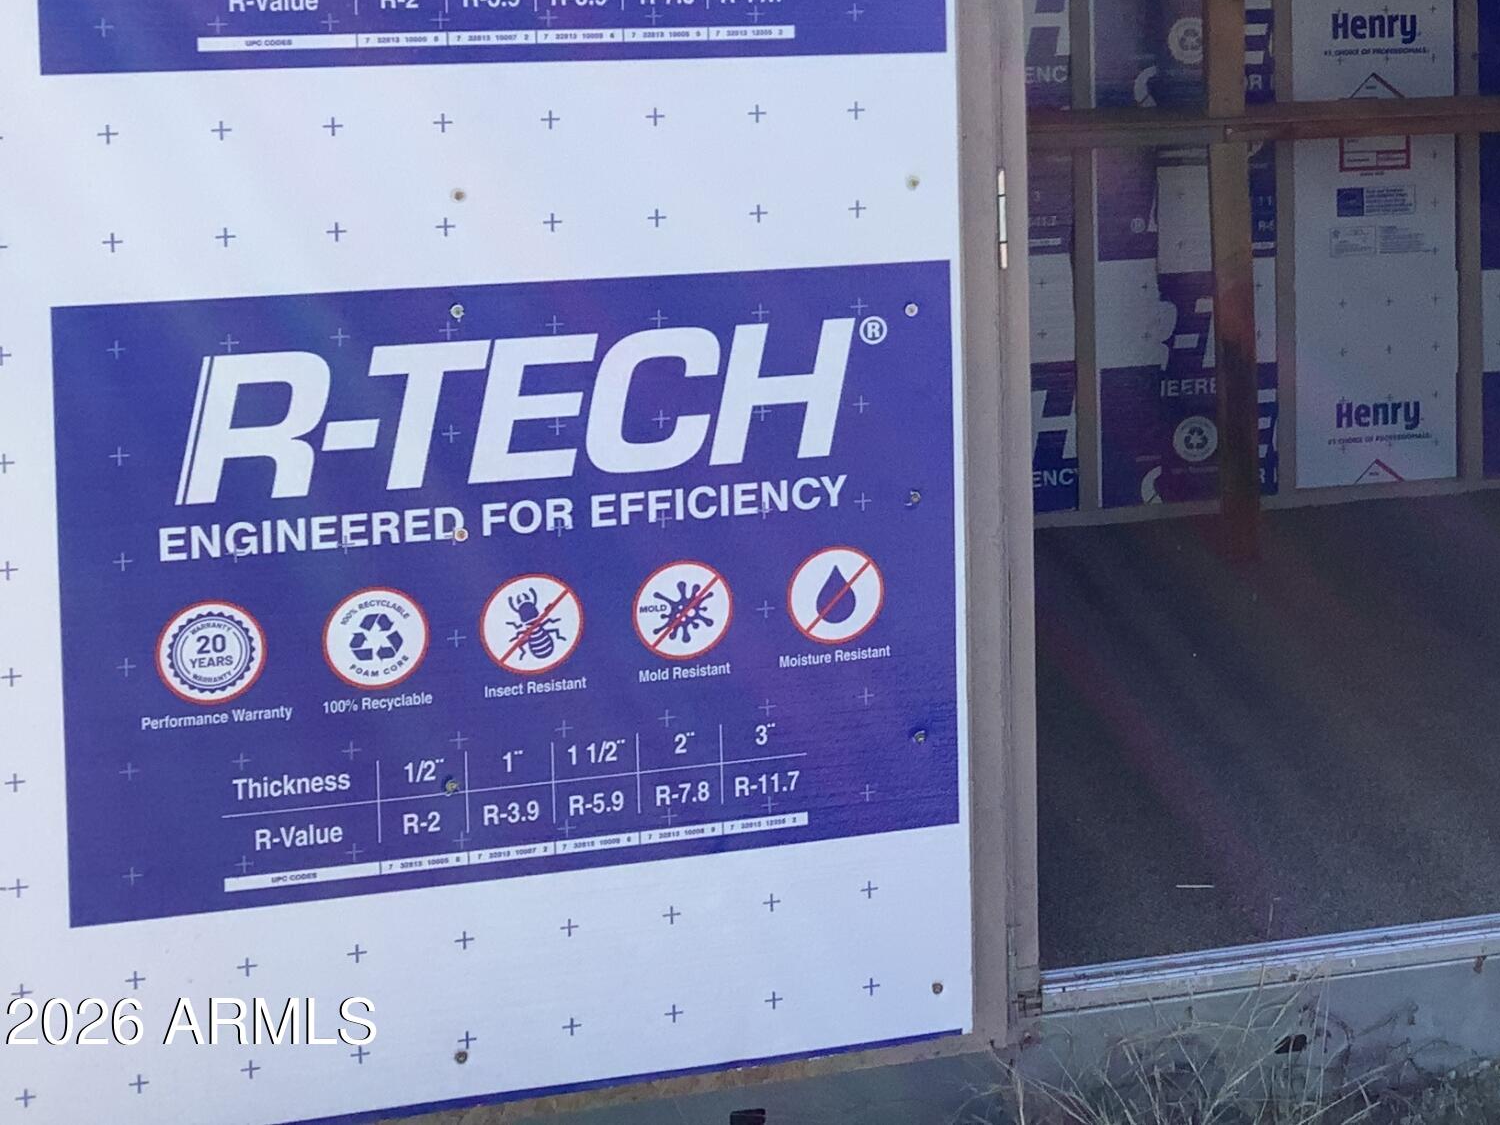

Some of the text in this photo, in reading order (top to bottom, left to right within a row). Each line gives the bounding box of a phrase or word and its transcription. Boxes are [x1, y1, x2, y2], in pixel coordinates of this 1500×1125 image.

[1331, 12, 1418, 45] Henry
[245, 39, 262, 47] UPC
[264, 38, 292, 47] CODES
[1336, 400, 1421, 431] Henry
[159, 475, 848, 562] ENGINEERED FOR EFFICIENCY
[357, 599, 411, 619] RECYCLABLE
[639, 603, 667, 614] MOLD
[190, 622, 232, 635] WARRANTY
[196, 634, 226, 655] 20
[189, 655, 233, 669] YEARS
[349, 654, 409, 677] FOAM CORE
[778, 644, 891, 669] Moisture Resistant
[638, 662, 731, 683] Mold Resistant
[484, 676, 587, 699] Insect Resistant
[322, 691, 433, 714] 100% Recyclable
[141, 705, 293, 731] Performance Warranty
[232, 772, 351, 801] Thickness
[567, 745, 577, 765] 1
[255, 770, 800, 852] R-Value R-2 R-3.9 R-5.9 R-7.8 R-11.7
[271, 876, 288, 884] UPC
[289, 872, 318, 882] CODES
